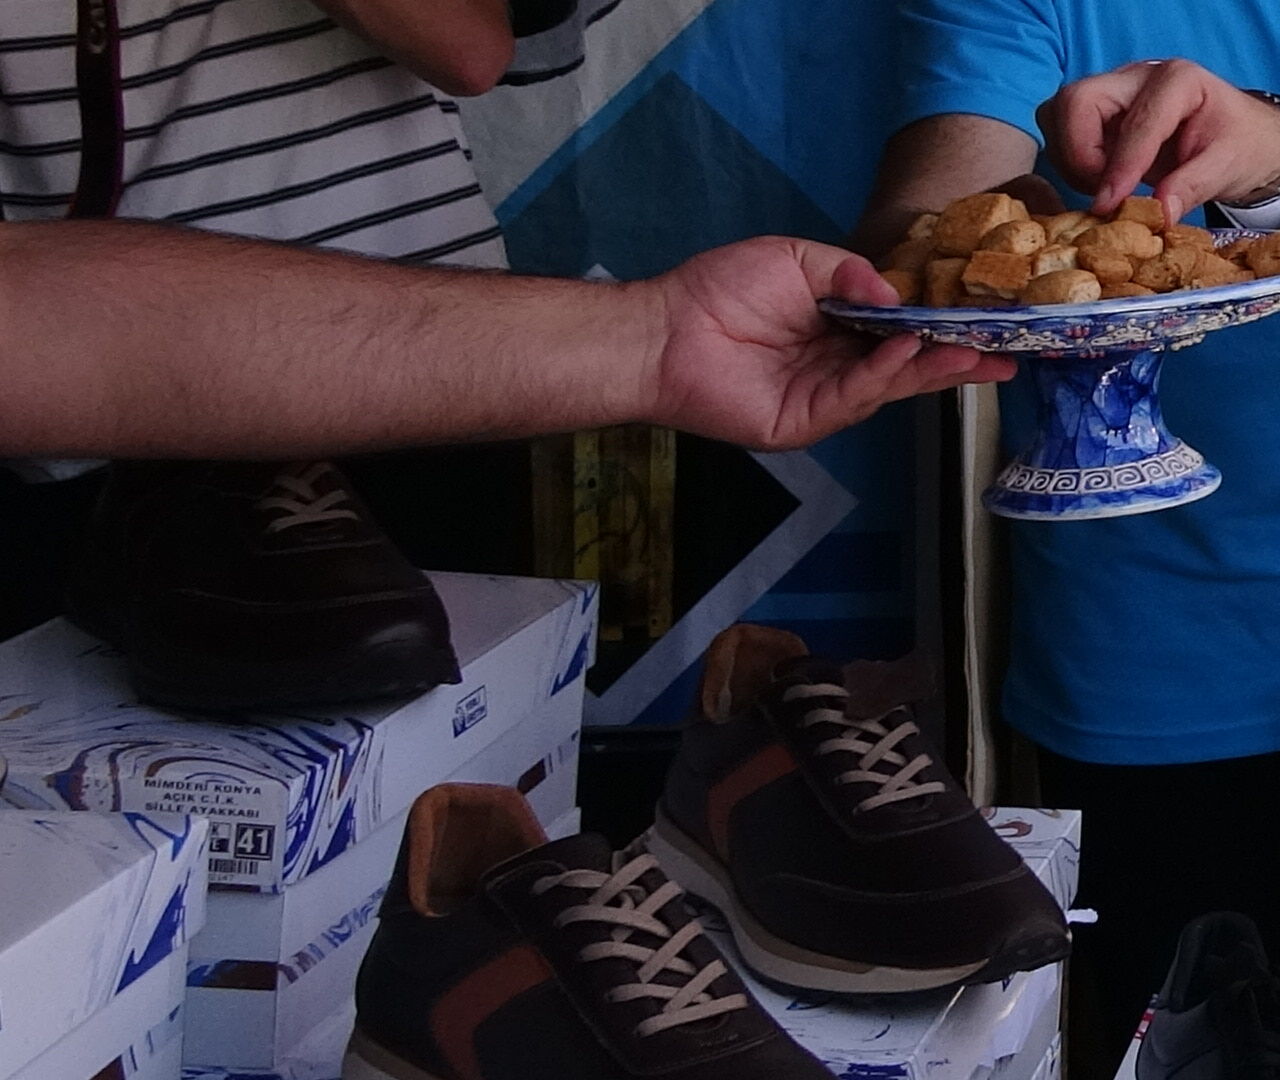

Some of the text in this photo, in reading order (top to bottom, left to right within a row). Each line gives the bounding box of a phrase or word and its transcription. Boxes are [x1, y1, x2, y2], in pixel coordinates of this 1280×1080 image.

[214, 784, 262, 795] KONYA
[163, 792, 196, 803] AÇIK
[144, 801, 260, 819] SİLLE AYAKKABI
[237, 828, 269, 855] 41
